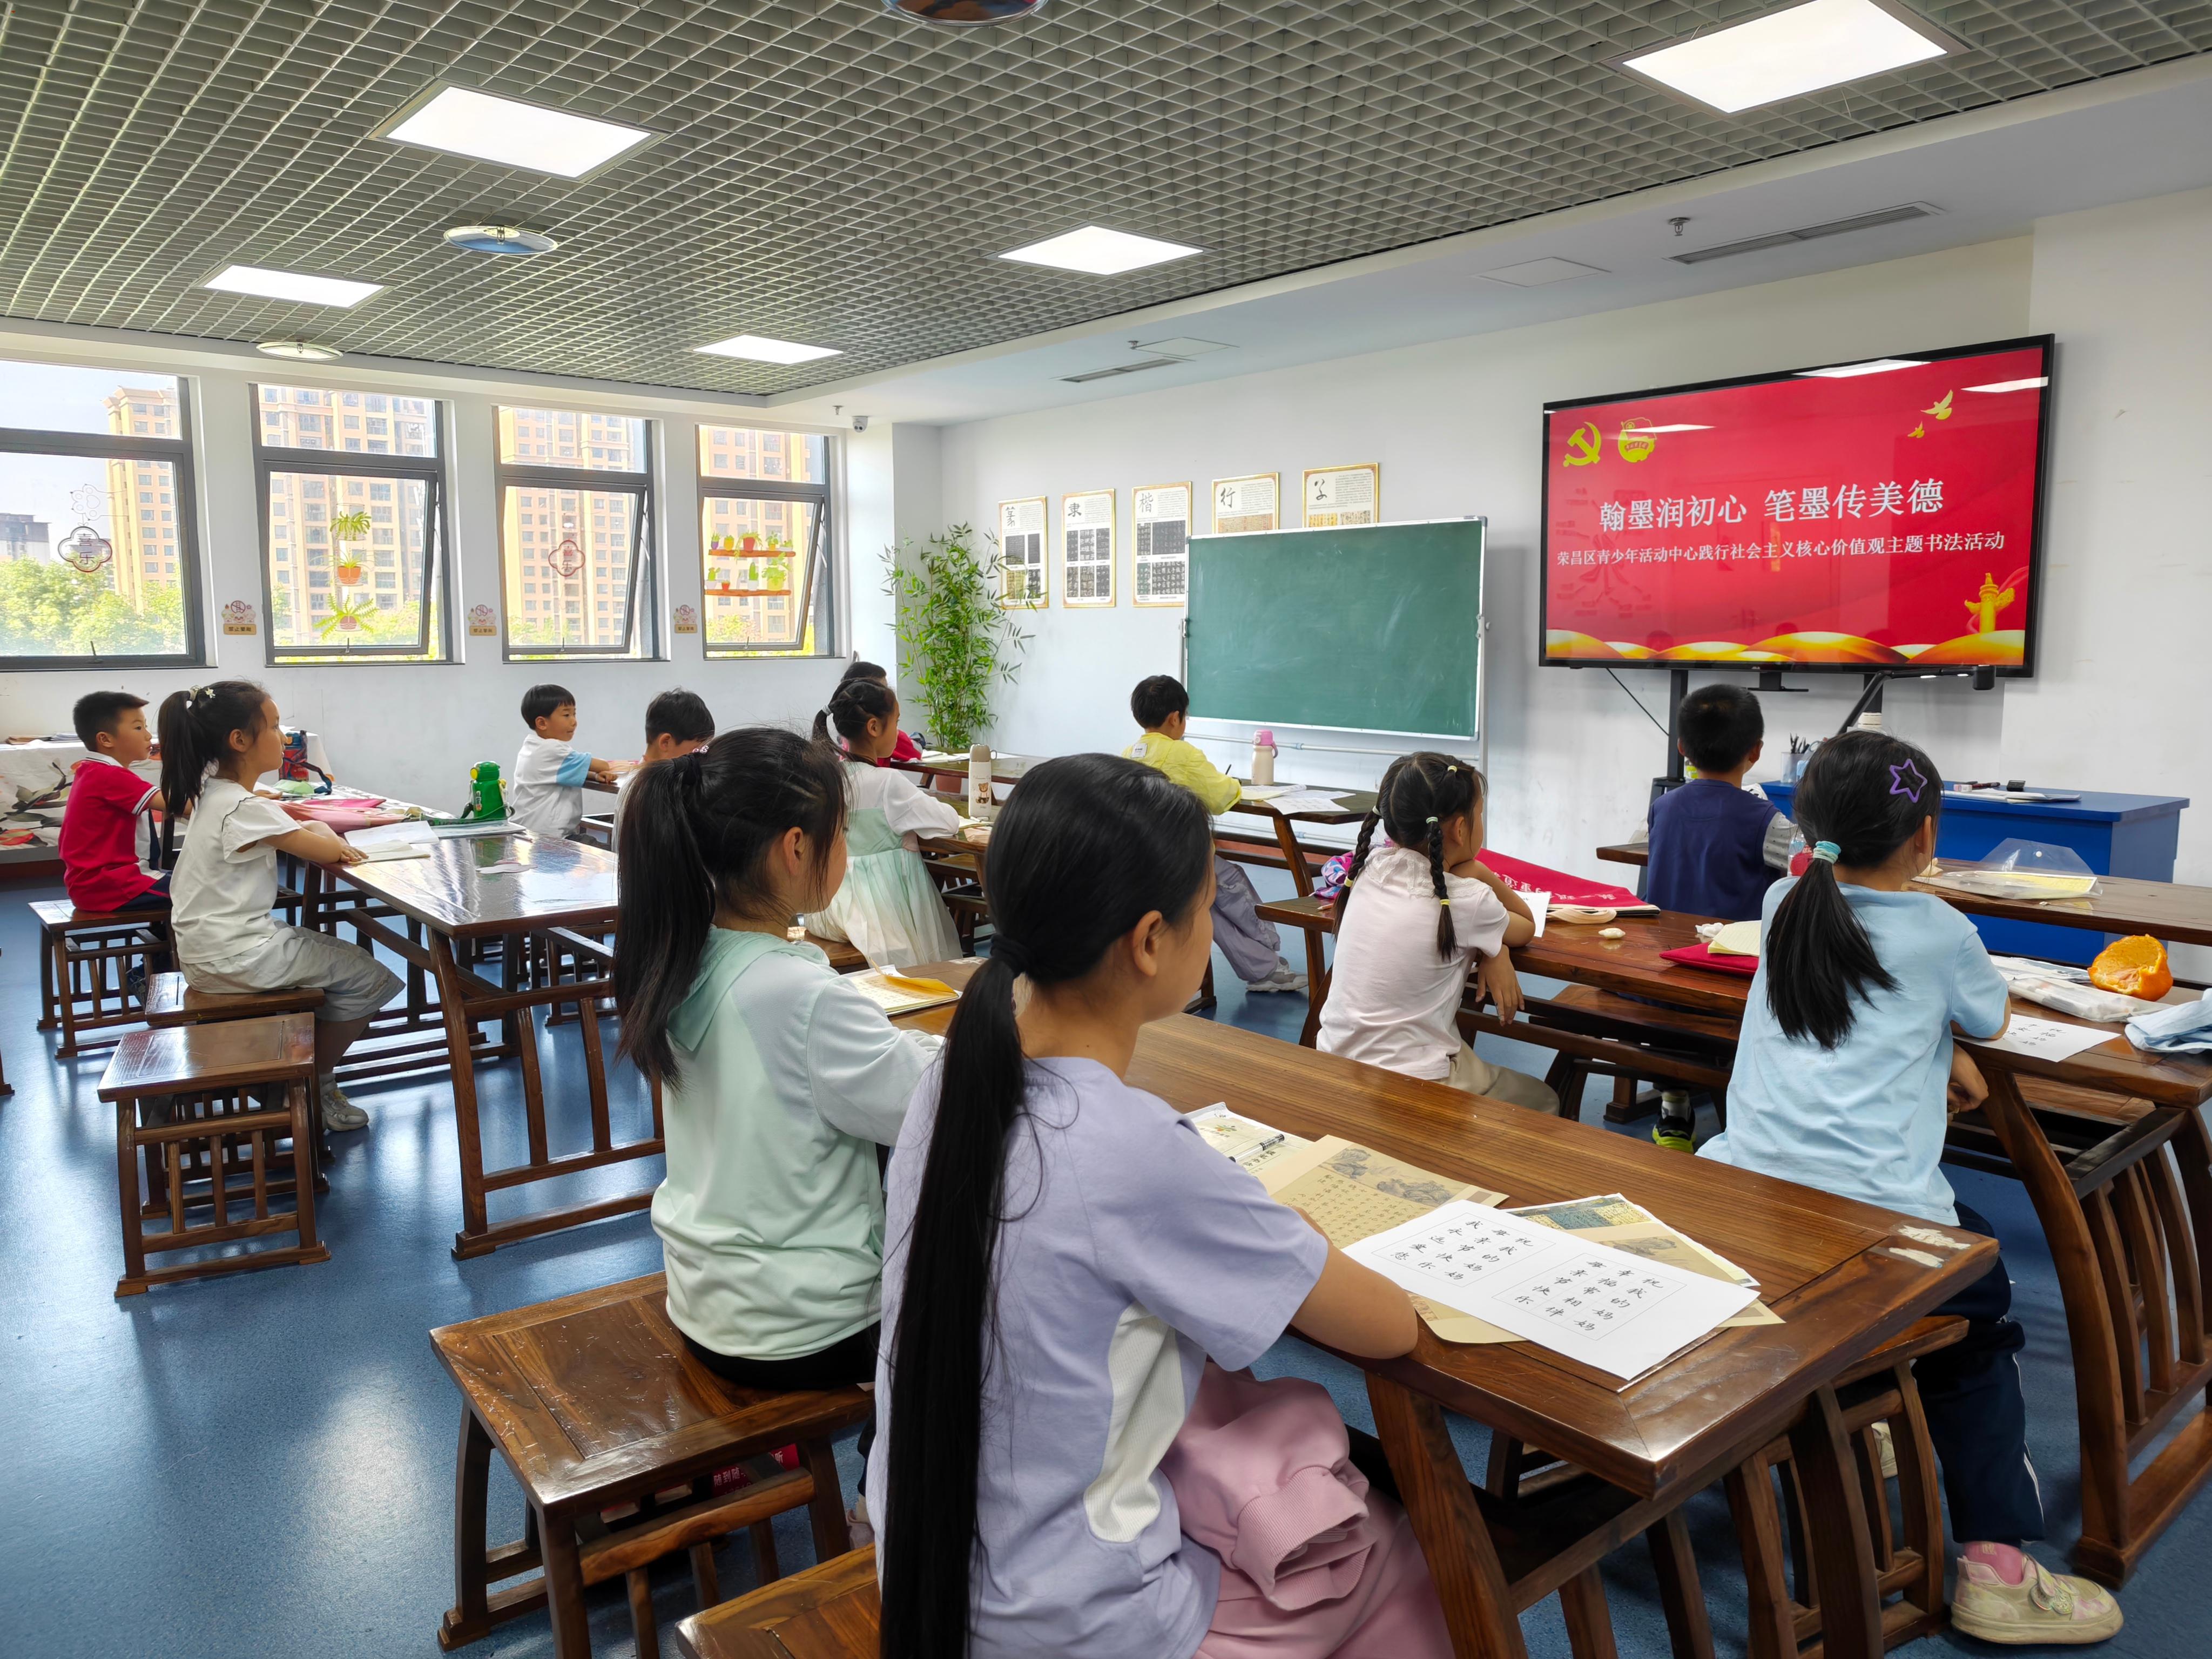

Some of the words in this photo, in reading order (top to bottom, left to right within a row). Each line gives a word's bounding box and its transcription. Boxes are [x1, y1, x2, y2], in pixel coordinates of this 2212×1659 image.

[1067, 502, 1082, 517] 隶
[1138, 492, 1154, 513] 楷
[1220, 487, 1236, 508] 行
[1599, 494, 1747, 532] 翰墨润初心
[1763, 478, 1944, 522] 笔墨传美德
[77, 533, 95, 564] 喜乐
[1557, 531, 2005, 566] 荣昌区青少年活动中心践行社会主义核心价值观主题书法活动
[1418, 1229, 1510, 1270] 母亲节快乐
[1444, 1237, 1534, 1280] 祝我的妈妈
[1514, 1260, 1607, 1305] 母亲节快乐
[1545, 1269, 1635, 1317] 幸福常相伴
[1573, 1278, 1664, 1331] 祝我的妈妈
[713, 1467, 746, 1487] 随到随
